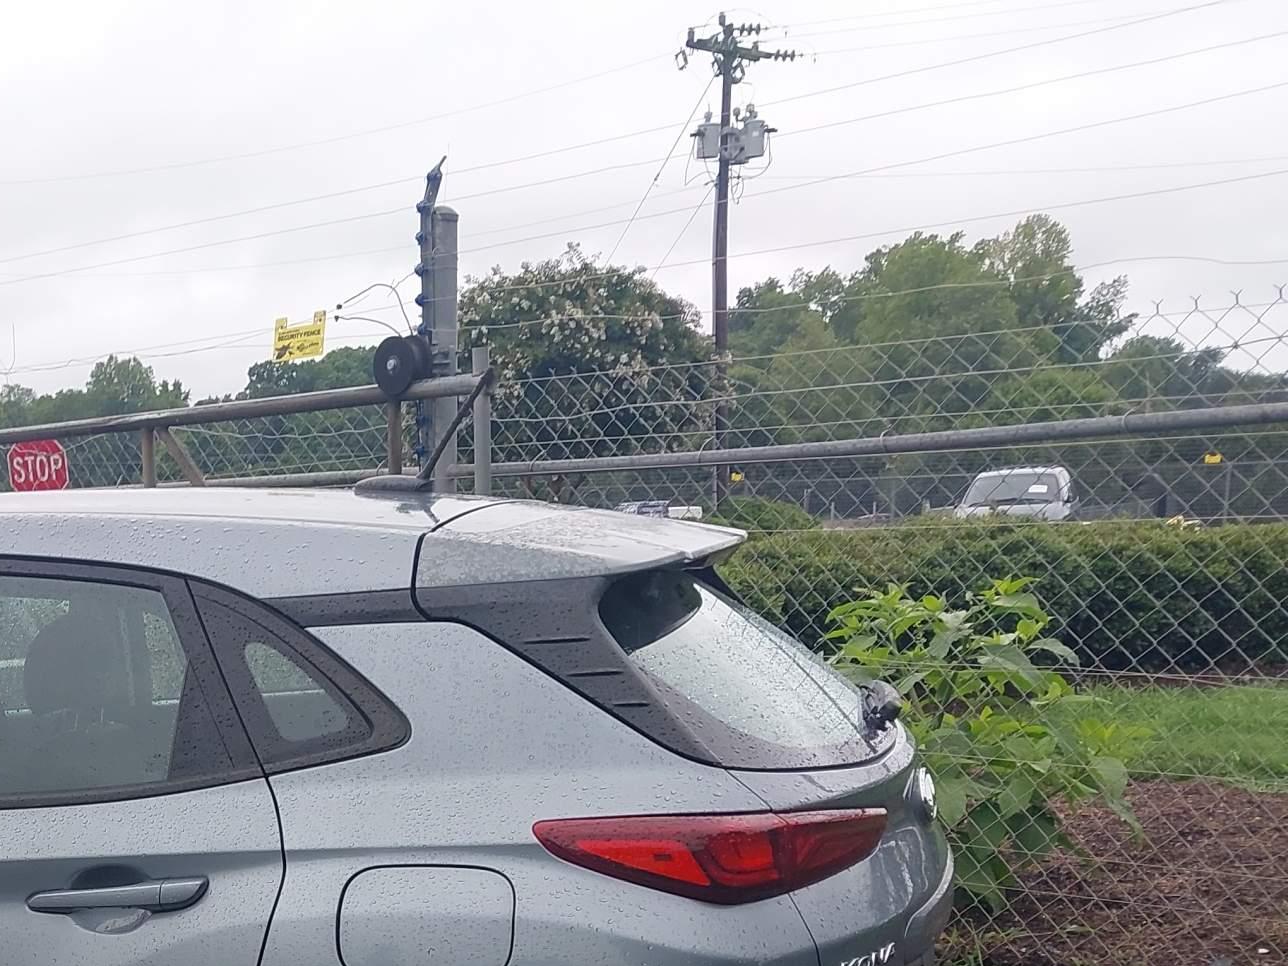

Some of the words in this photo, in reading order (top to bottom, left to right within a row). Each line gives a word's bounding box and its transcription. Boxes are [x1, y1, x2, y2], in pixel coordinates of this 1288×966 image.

[278, 331, 303, 342] SECURITY
[304, 328, 321, 337] FENCE
[13, 454, 63, 483] STOP
